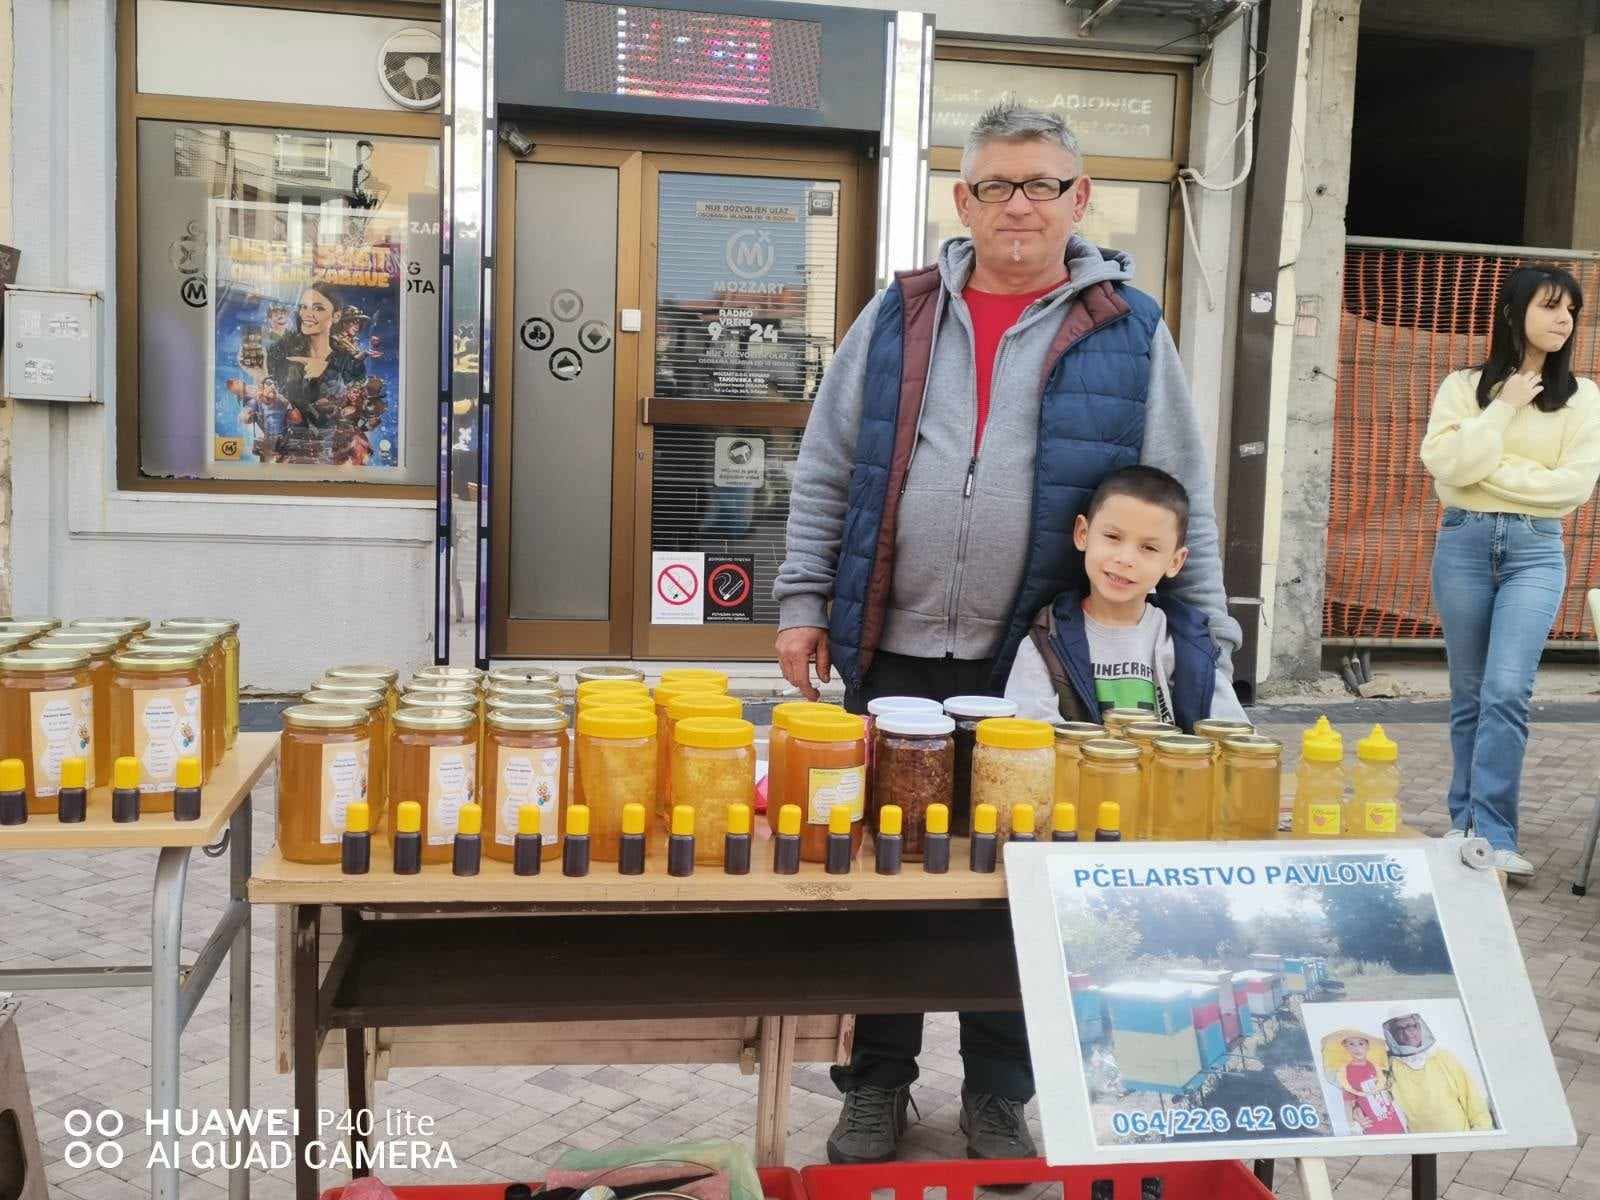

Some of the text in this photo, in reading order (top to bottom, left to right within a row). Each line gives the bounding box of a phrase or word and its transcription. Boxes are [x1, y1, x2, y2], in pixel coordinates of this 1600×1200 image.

[713, 280, 785, 295] MOZZART
[719, 308, 753, 318] RADNO
[719, 318, 752, 327] VREME
[707, 321, 722, 341] 9
[749, 323, 778, 343] 24
[1092, 661, 1153, 678] INECRAF
[1073, 858, 1405, 888] PČELARSTVO PAVLOVIĆ
[1112, 1104, 1320, 1137] 064/226 42 06
